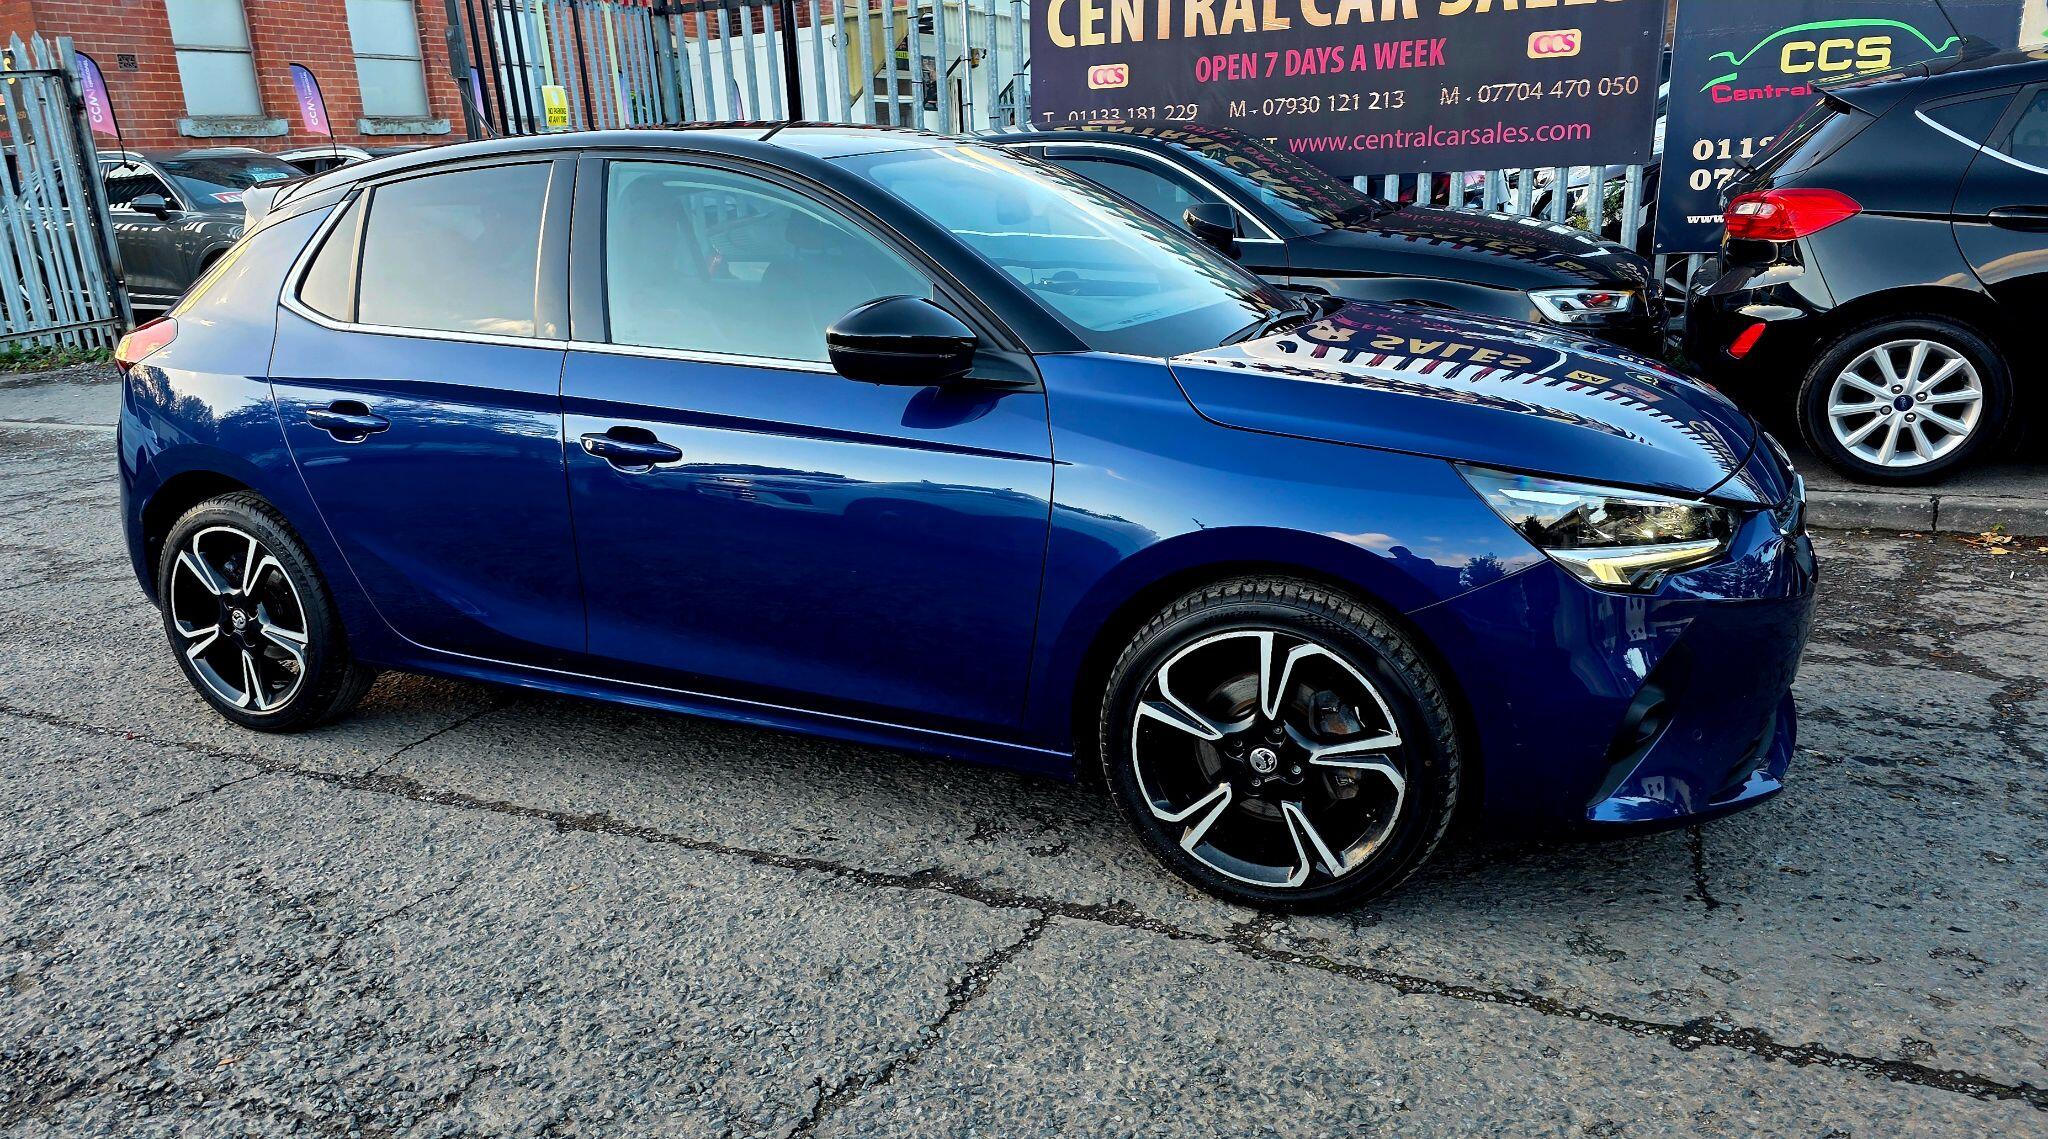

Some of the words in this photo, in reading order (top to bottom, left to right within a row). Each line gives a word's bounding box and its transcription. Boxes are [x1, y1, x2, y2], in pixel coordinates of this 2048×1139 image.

[1533, 33, 1577, 55] CCS
[1780, 36, 1892, 73] CCS
[1195, 52, 1258, 83] OPEN
[1264, 52, 1279, 78] 7
[1285, 46, 1345, 77] DAYS
[1350, 44, 1367, 72] A
[1373, 37, 1447, 70] WEEK
[1092, 67, 1125, 86] CCS
[1477, 81, 1544, 103] 07704
[1548, 78, 1591, 98] 470
[1597, 75, 1640, 97] 050
[1262, 95, 1321, 116] 07930
[1327, 93, 1360, 112] 121
[1367, 90, 1406, 110] 213
[1711, 83, 1812, 104] Central
[1163, 103, 1199, 121] 229
[1289, 121, 1592, 153] www.centralcarsales.com
